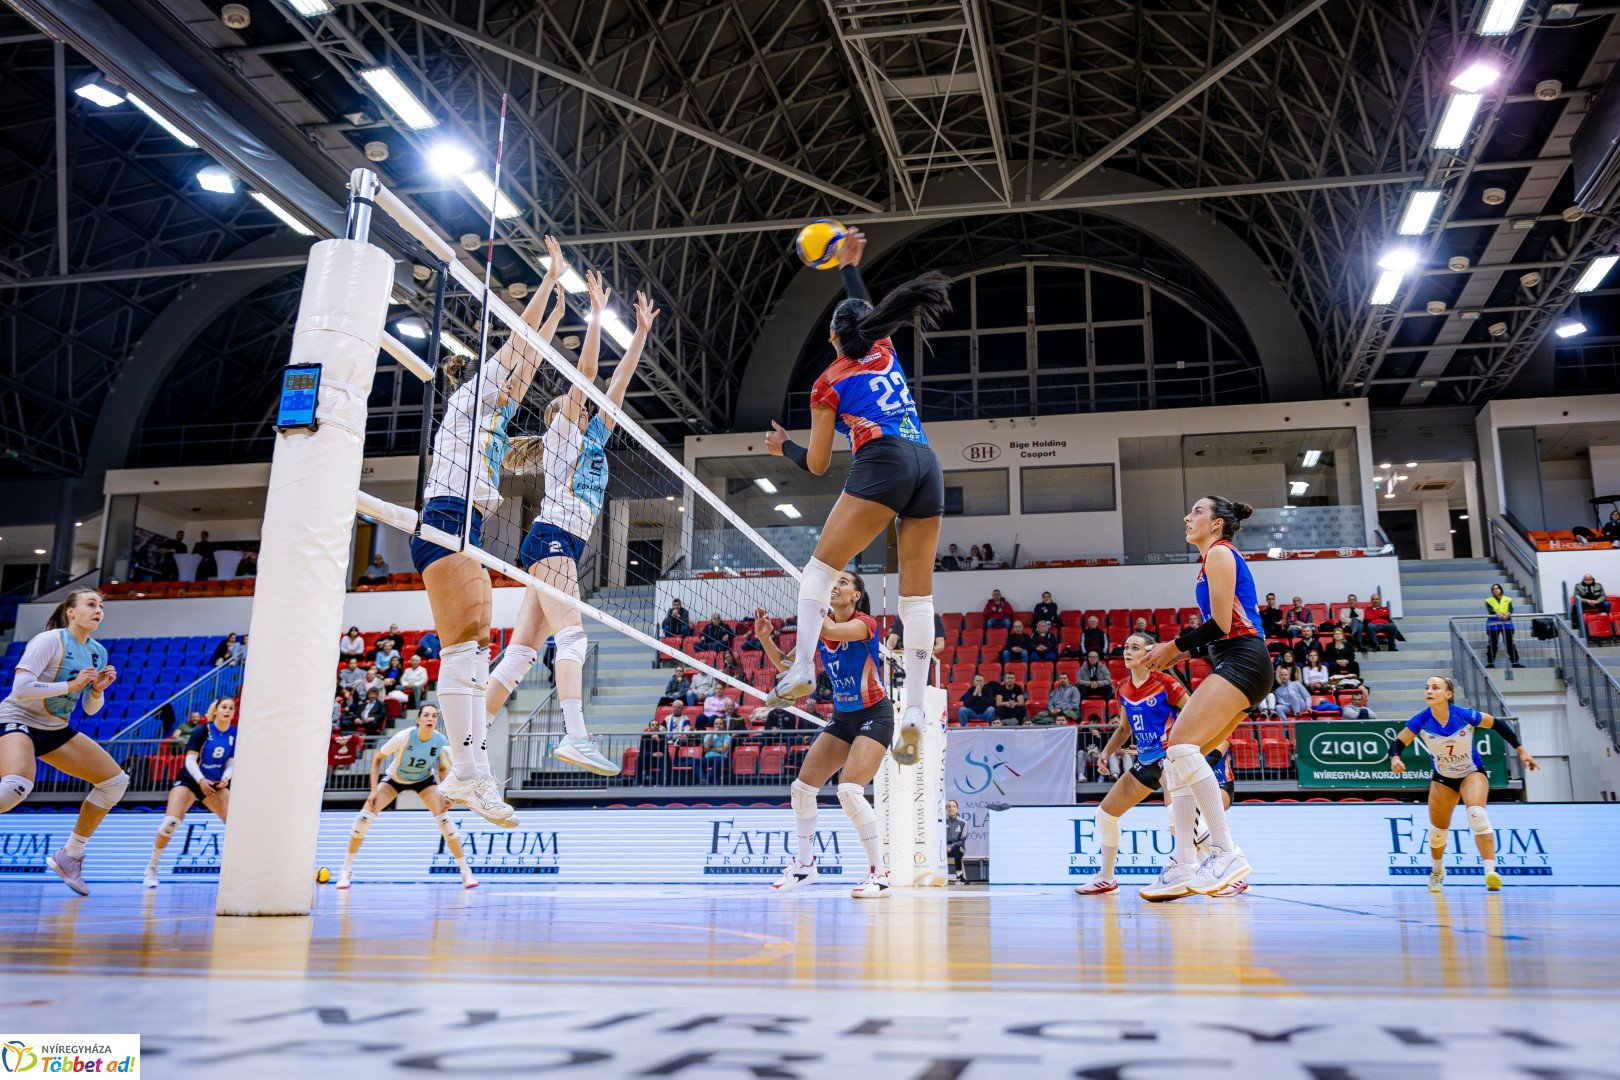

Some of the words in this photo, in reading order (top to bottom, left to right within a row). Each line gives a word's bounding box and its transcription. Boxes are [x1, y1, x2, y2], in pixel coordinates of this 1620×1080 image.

[869, 371, 916, 412] 22
[1009, 441, 1030, 450] Bige
[1032, 440, 1067, 448] Holding
[970, 446, 994, 459] BH
[1020, 450, 1057, 459] Csoport
[5, 723, 30, 734] 24
[1132, 714, 1144, 731] 21
[212, 746, 226, 759] 8
[1321, 740, 1379, 761] ziaja
[1446, 745, 1456, 757] 7
[407, 757, 427, 769] 12
[432, 856, 560, 865] PROPERTY
[705, 856, 842, 865] PROPETY
[1389, 856, 1550, 865] PRPERTY
